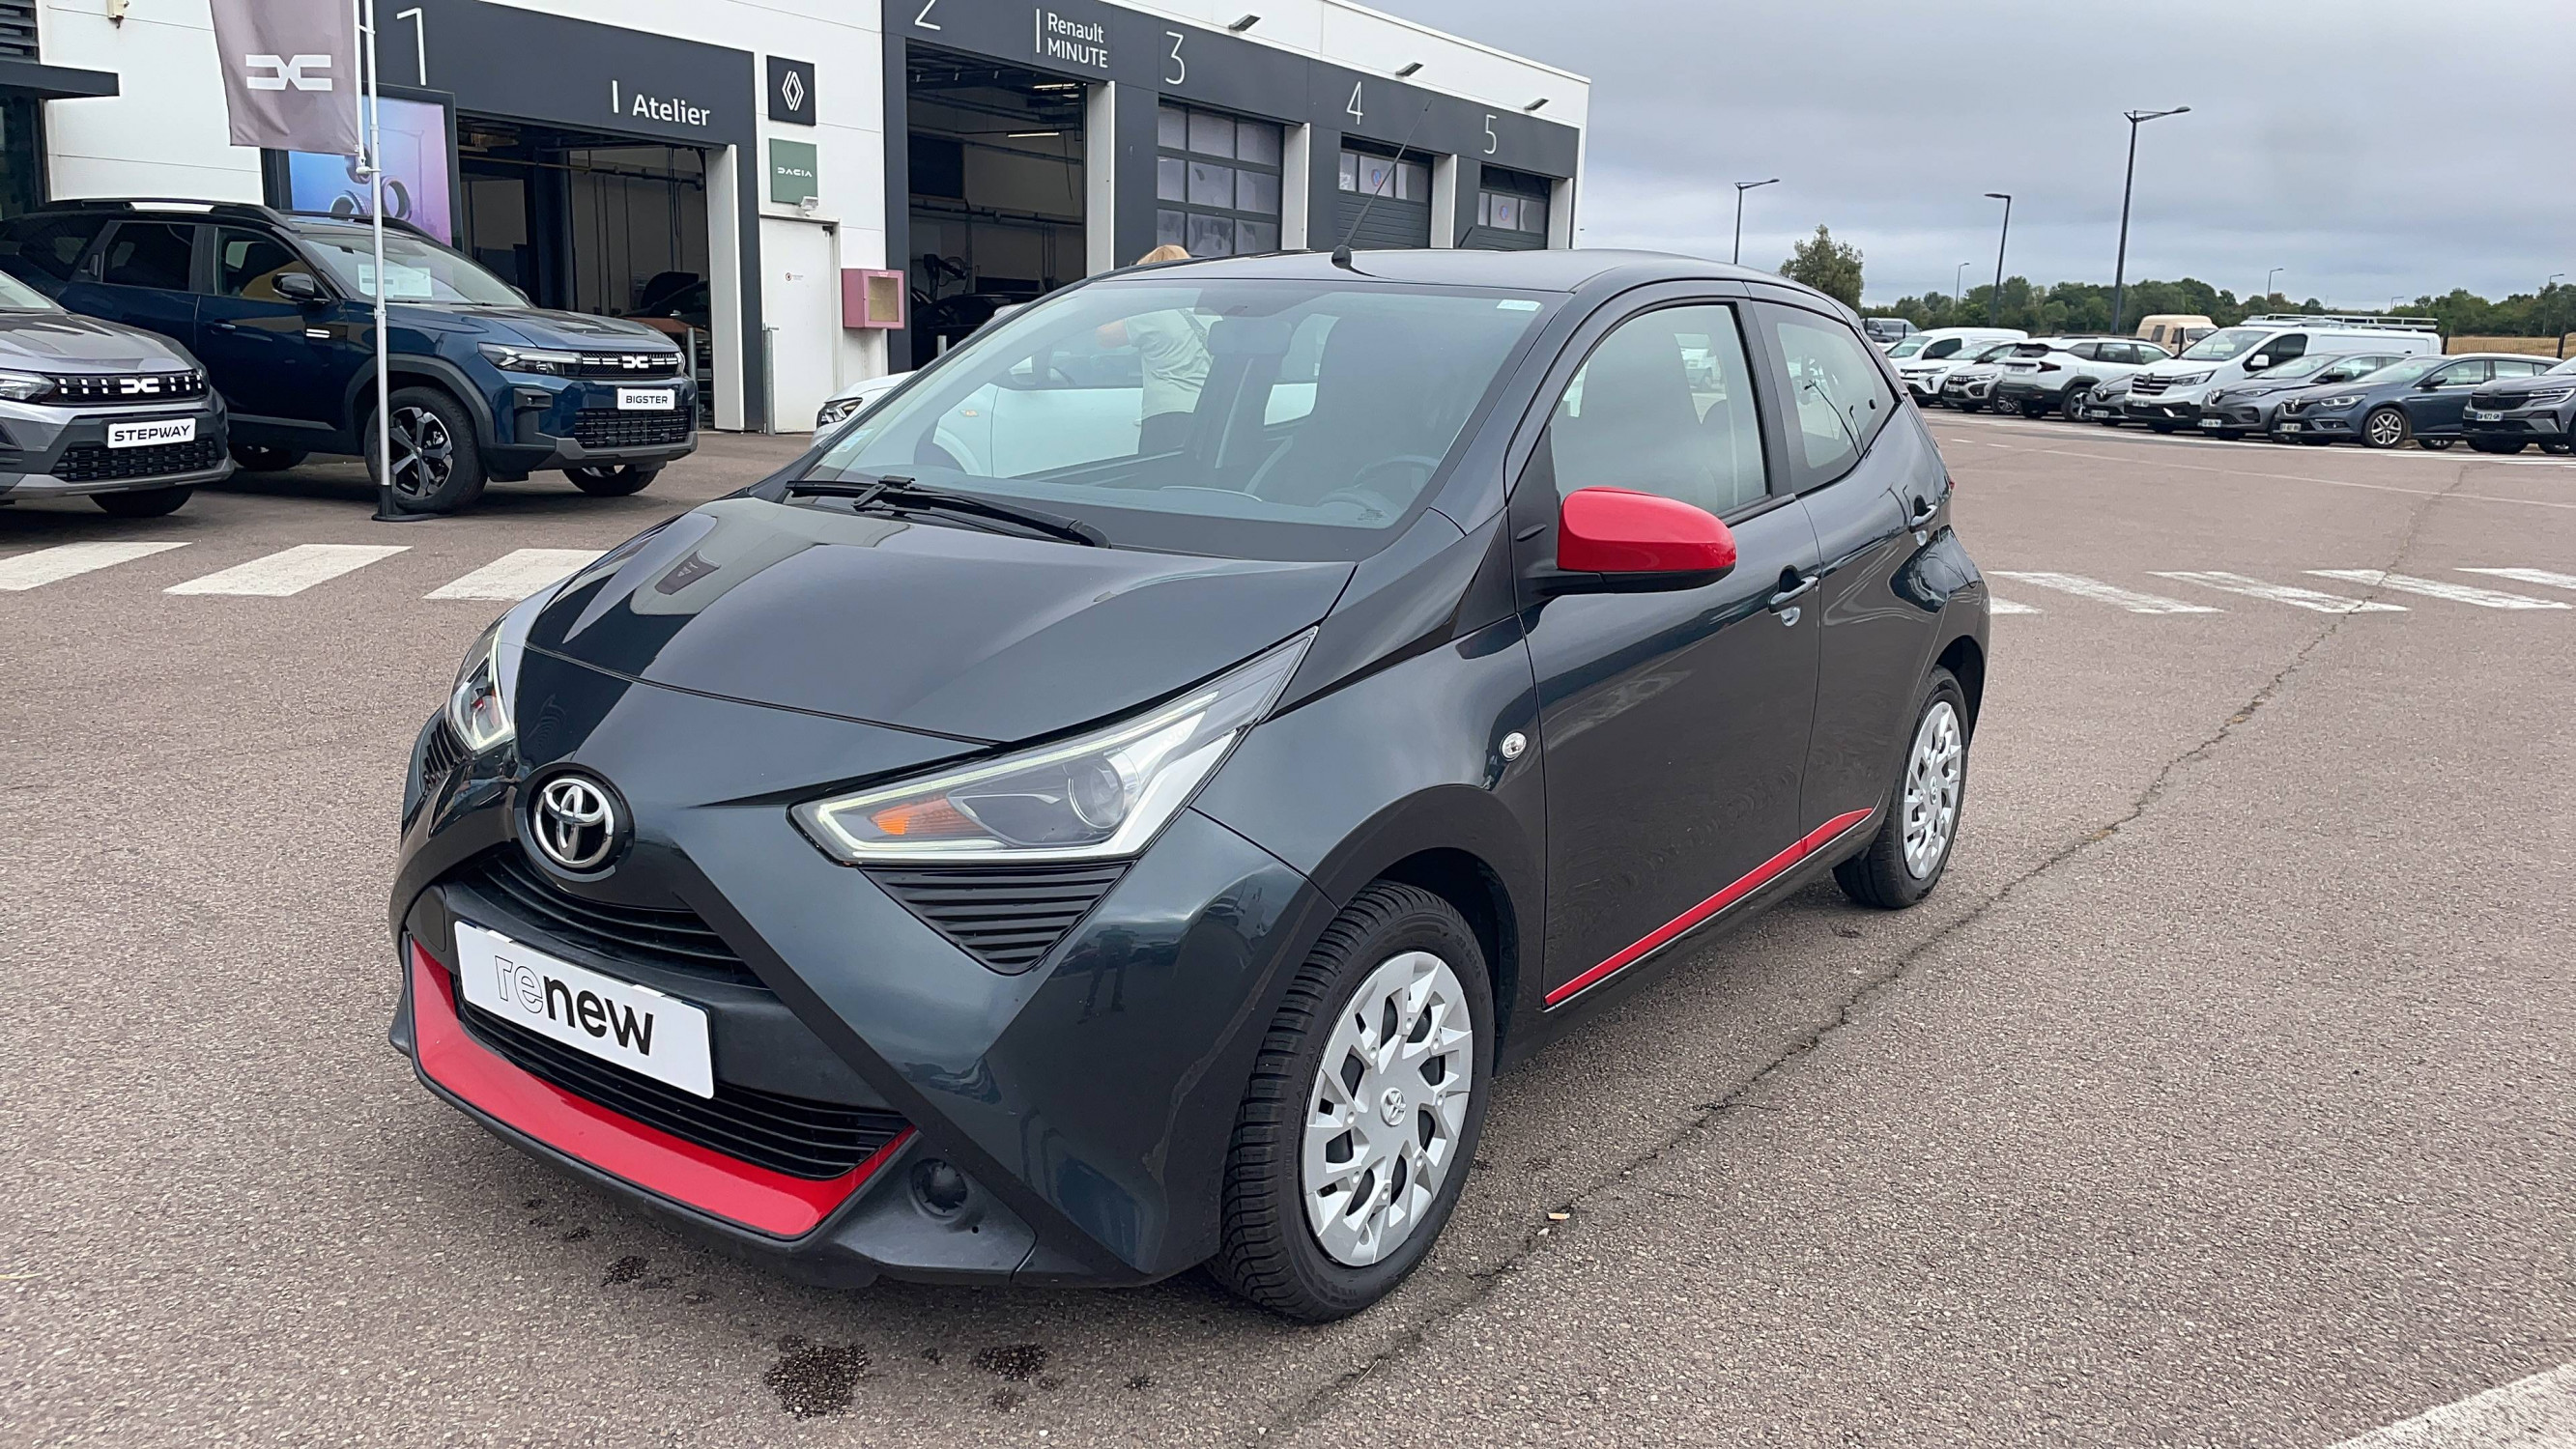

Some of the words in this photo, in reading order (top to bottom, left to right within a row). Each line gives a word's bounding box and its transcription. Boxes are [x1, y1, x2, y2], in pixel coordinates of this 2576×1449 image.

[1047, 12, 1104, 44] Renault
[396, 7, 427, 86] 1
[1047, 37, 1109, 69] MINUTE
[1164, 30, 1186, 85] 3
[631, 94, 711, 127] Atelier
[1346, 80, 1364, 126] 4
[1483, 113, 1498, 156] 5
[777, 166, 813, 178] DACIA
[625, 395, 669, 405] BIGSTER
[114, 424, 190, 441] STEPWAY
[494, 954, 654, 1057] renew
